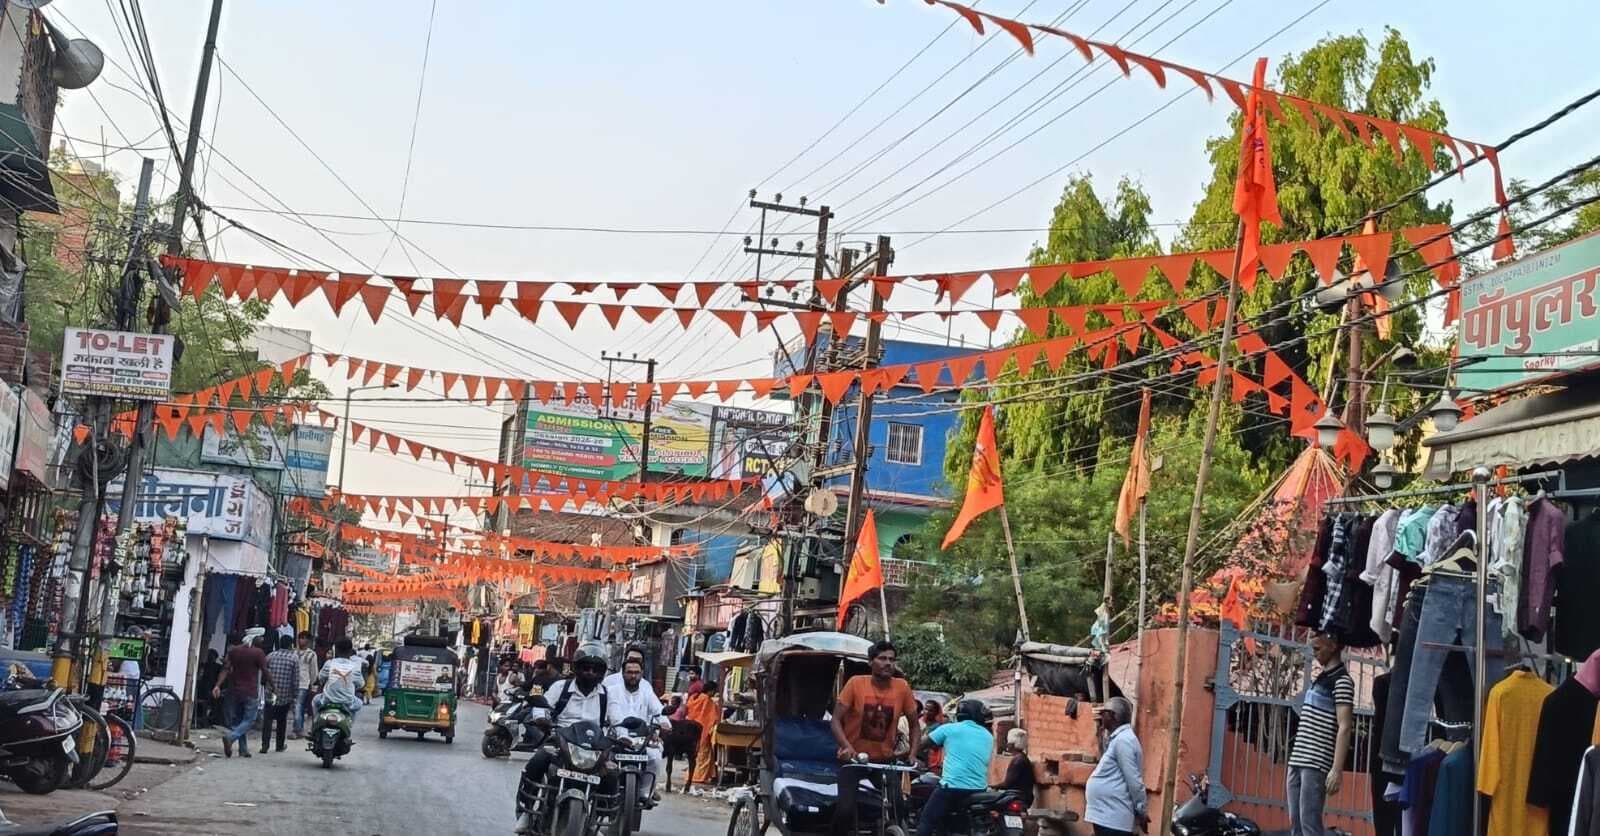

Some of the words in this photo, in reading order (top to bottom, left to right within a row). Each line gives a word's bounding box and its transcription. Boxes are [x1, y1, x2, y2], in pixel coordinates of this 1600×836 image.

[1464, 268, 1600, 355] पॉपुलर
[76, 331, 165, 356] TO-LET
[745, 457, 769, 475] RCT
